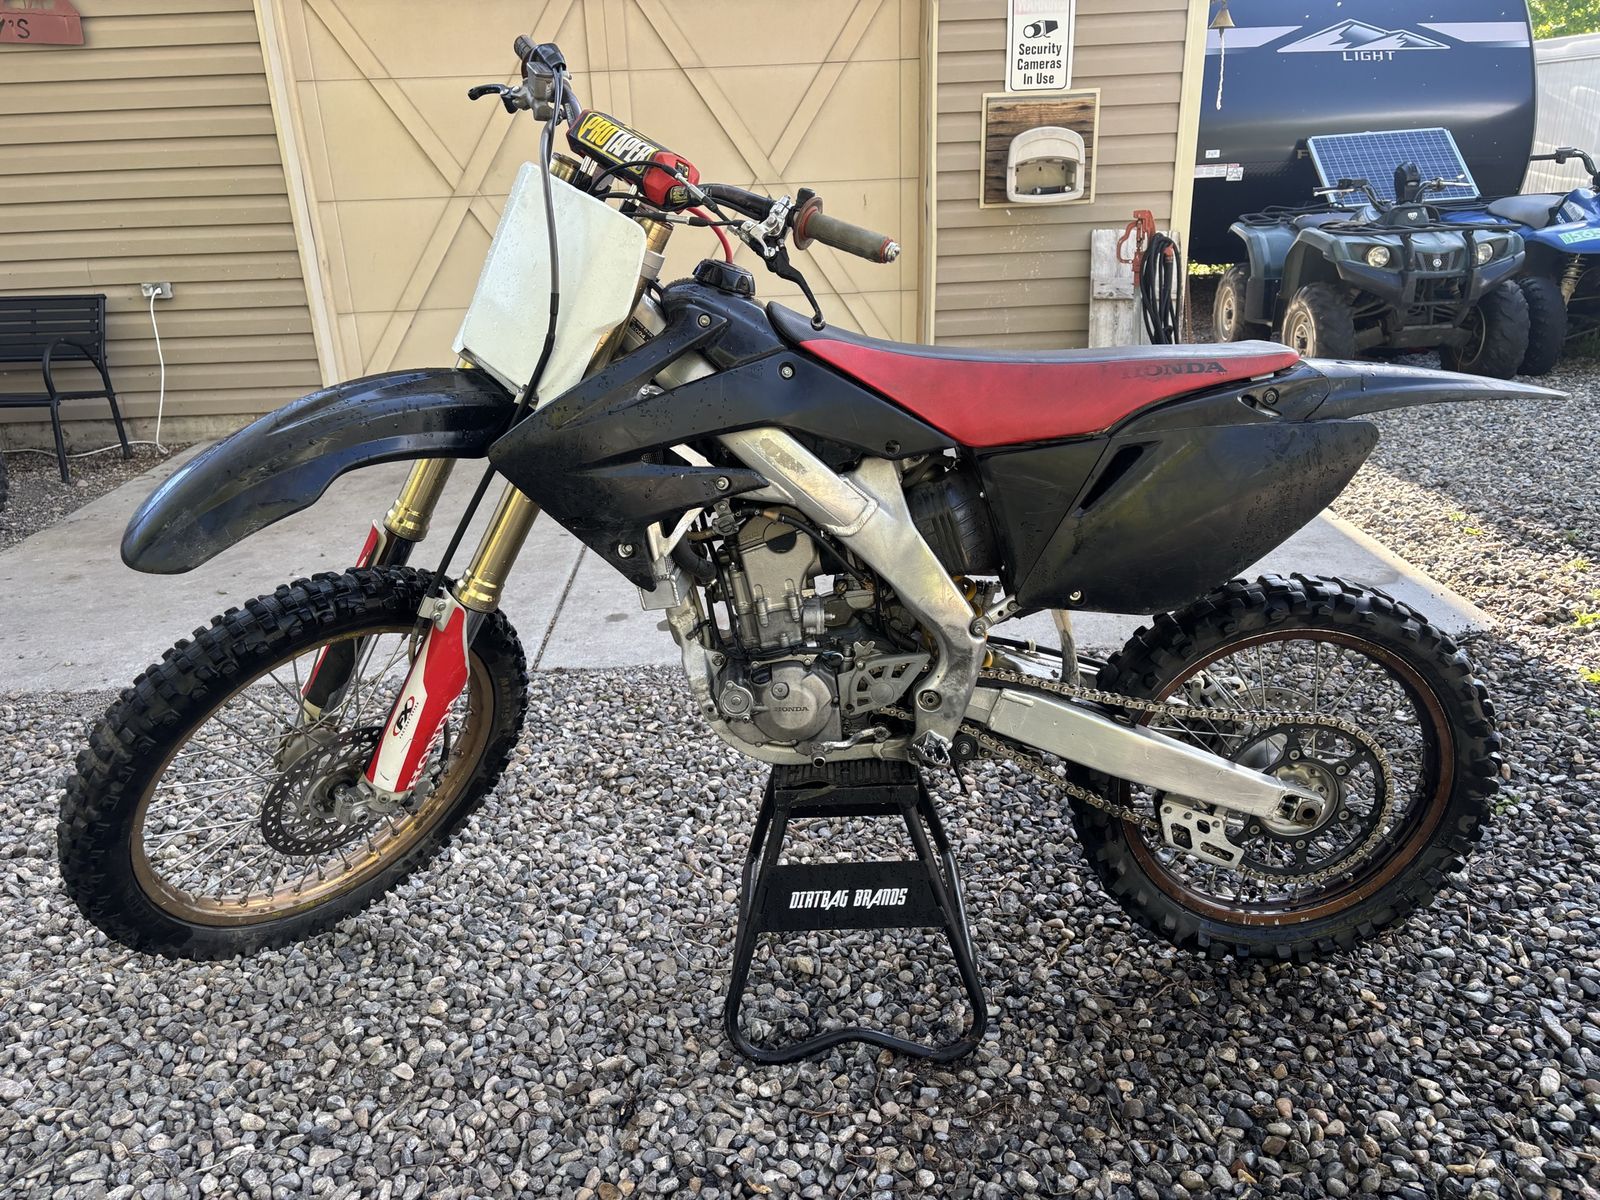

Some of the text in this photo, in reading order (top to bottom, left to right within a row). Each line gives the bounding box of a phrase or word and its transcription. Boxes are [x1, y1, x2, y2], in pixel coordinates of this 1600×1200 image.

[1018, 42, 1062, 56] Security
[1342, 51, 1396, 61] LIGHT
[1017, 58, 1062, 70] Cameras
[1023, 73, 1055, 85] In Use
[1121, 361, 1228, 379] HONDA
[395, 699, 413, 733] FX
[789, 888, 908, 910] DIRTBAG BRANDS
